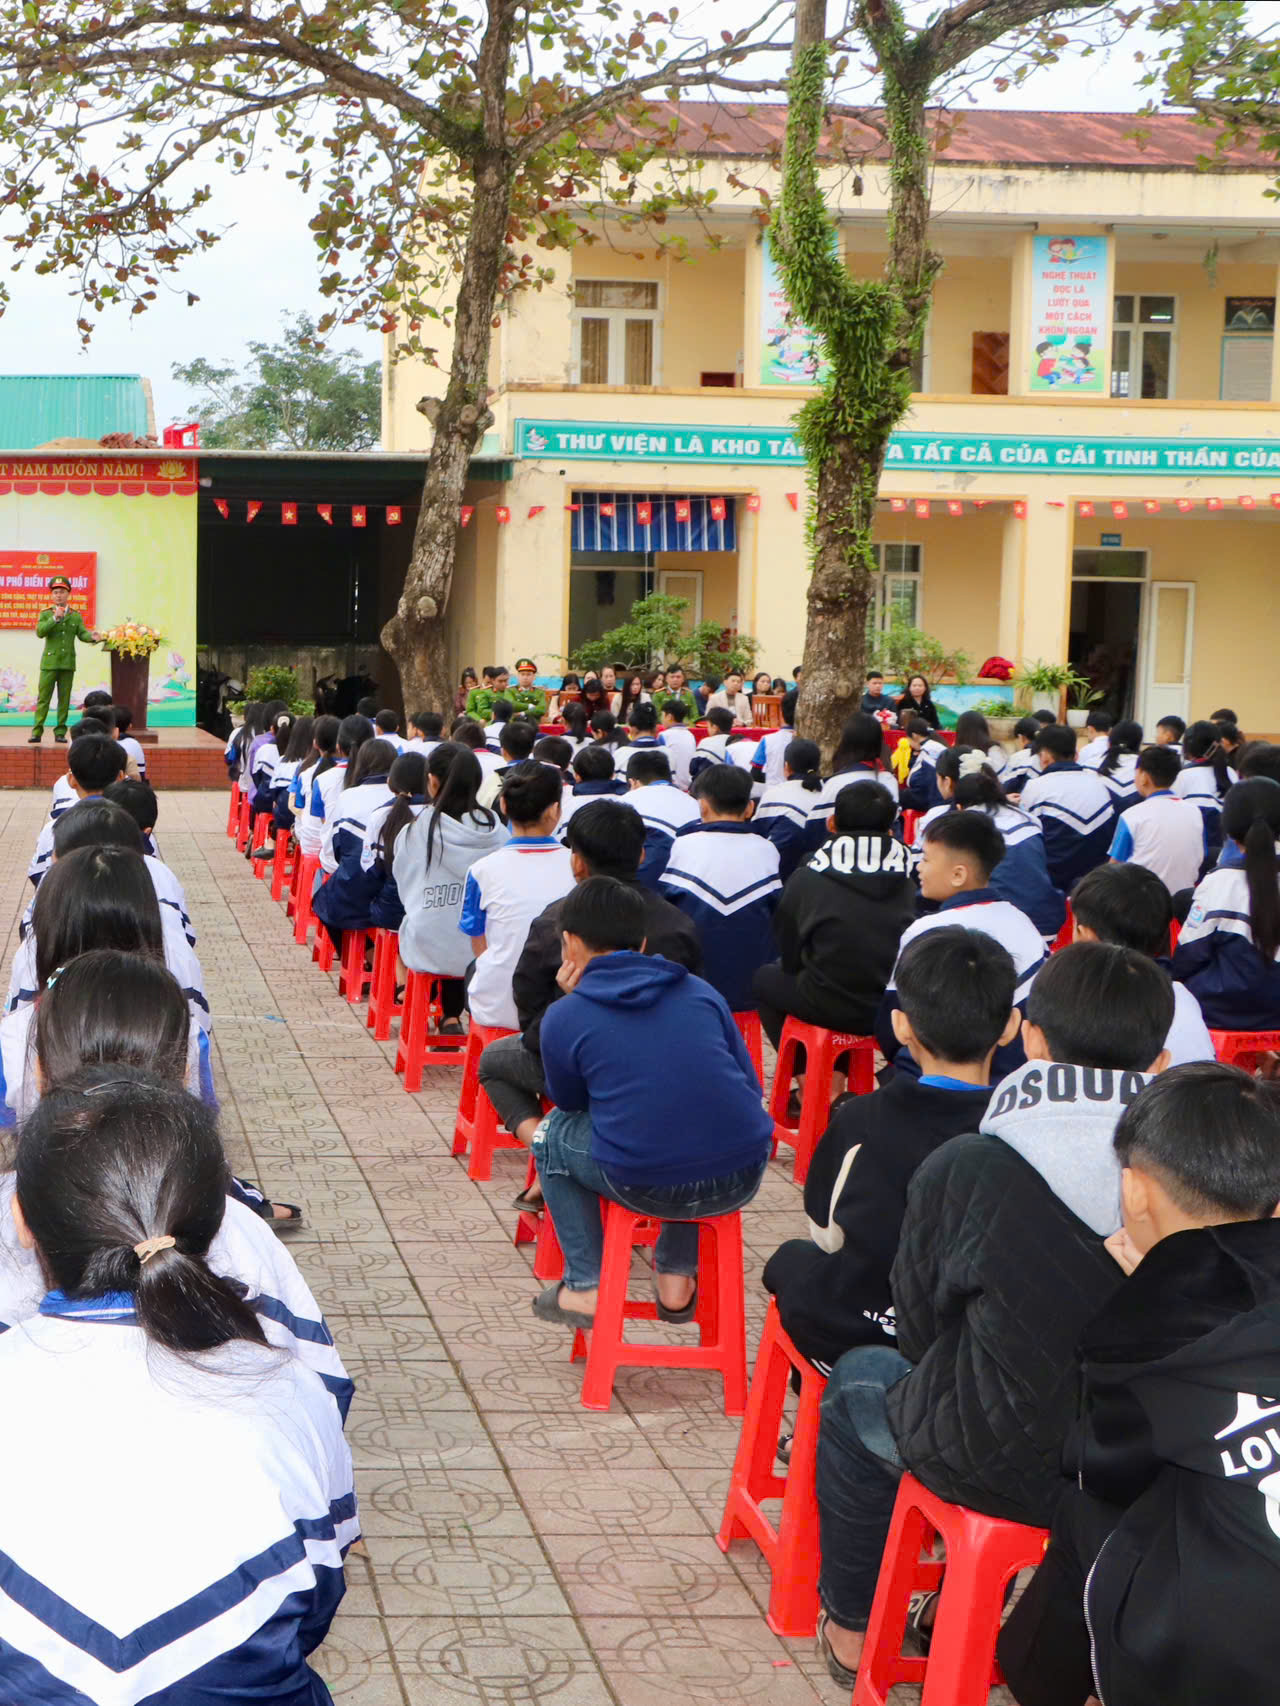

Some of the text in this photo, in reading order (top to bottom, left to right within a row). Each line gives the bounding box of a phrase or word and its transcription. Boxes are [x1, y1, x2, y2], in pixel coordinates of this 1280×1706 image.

[557, 433, 605, 450] THƯ
[611, 433, 667, 455] VIỆN
[674, 435, 705, 453] LÀ
[711, 438, 761, 455] KHO
[912, 441, 954, 462] TẤT
[960, 442, 993, 463] CẢ
[1000, 443, 1048, 464] CỦA
[1056, 444, 1095, 465] CẢI
[1103, 449, 1157, 466] TINH
[1164, 446, 1227, 467] THẦN
[12, 463, 47, 477] NAM
[423, 882, 464, 909] CHO
[989, 1063, 1147, 1120] DSQUA
